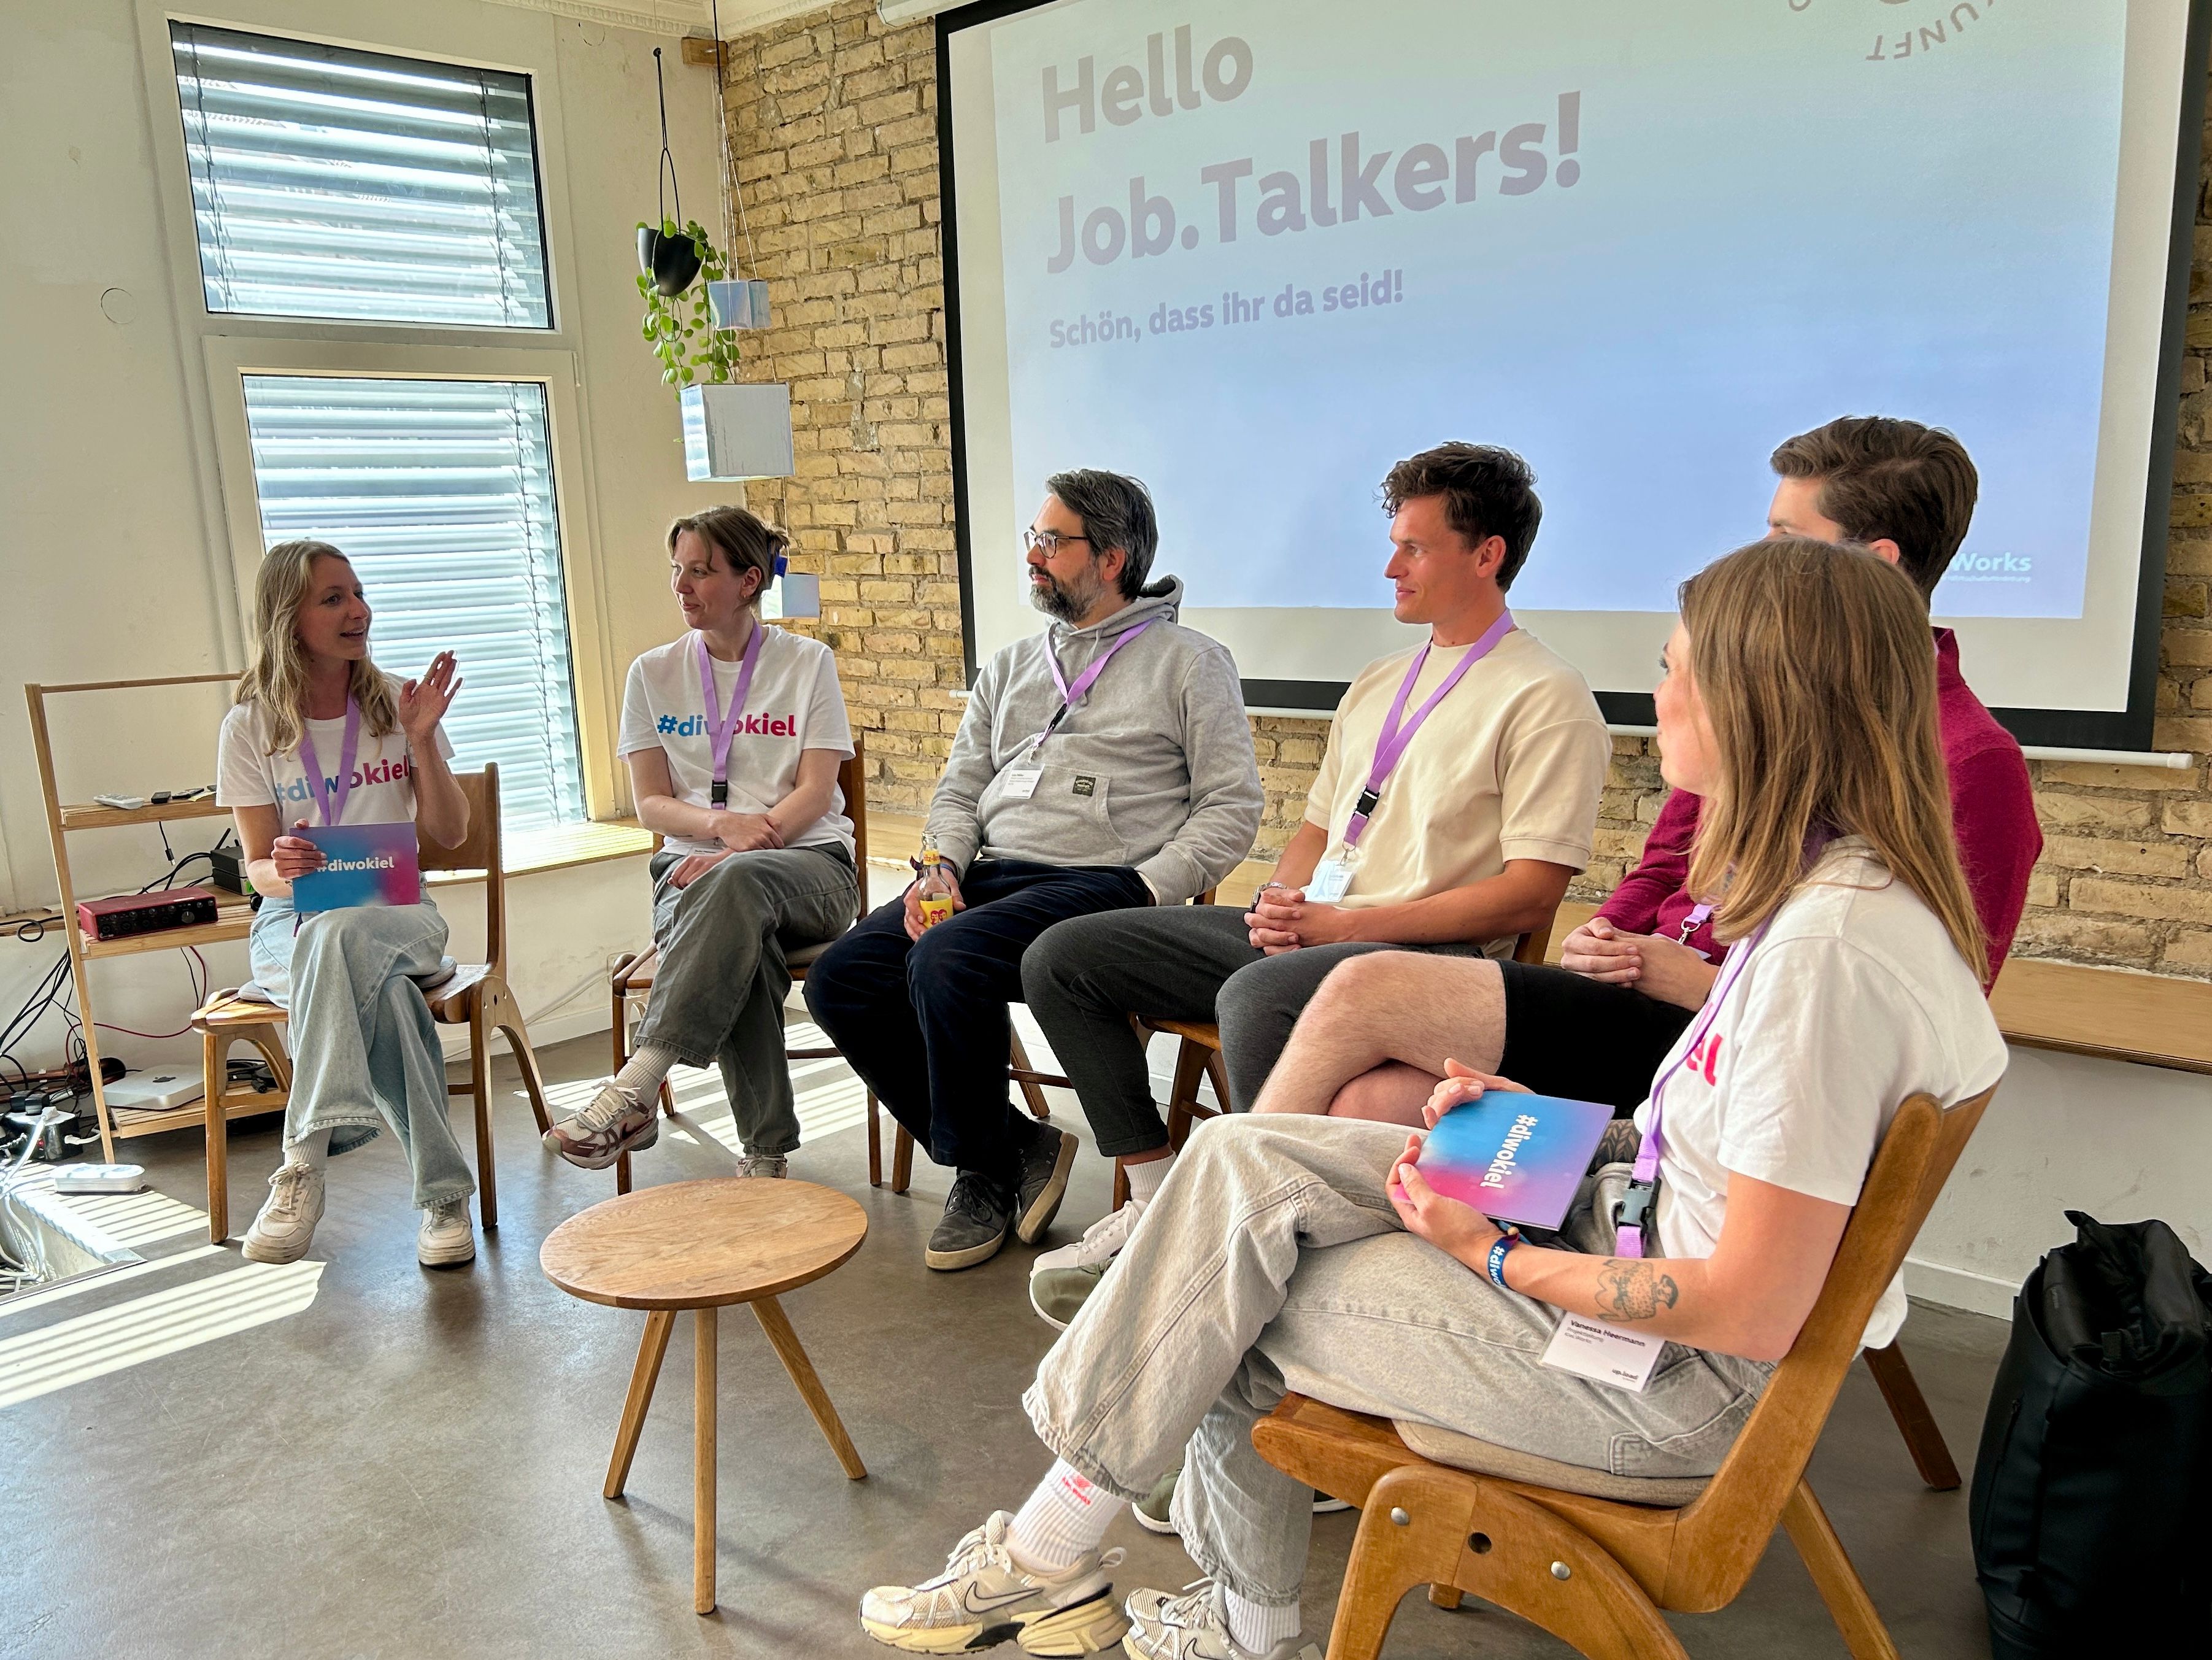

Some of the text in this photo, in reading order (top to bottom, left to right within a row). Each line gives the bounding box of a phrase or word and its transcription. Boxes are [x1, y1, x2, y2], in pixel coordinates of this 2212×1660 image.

[1865, 0, 1994, 60] UNFT
[1042, 23, 1253, 143] Hello
[1046, 90, 1581, 273] Job.Talkers!
[1049, 269, 1403, 348] Schön, dass ihr da seid!
[1479, 1114, 1538, 1189] #diwokiel
